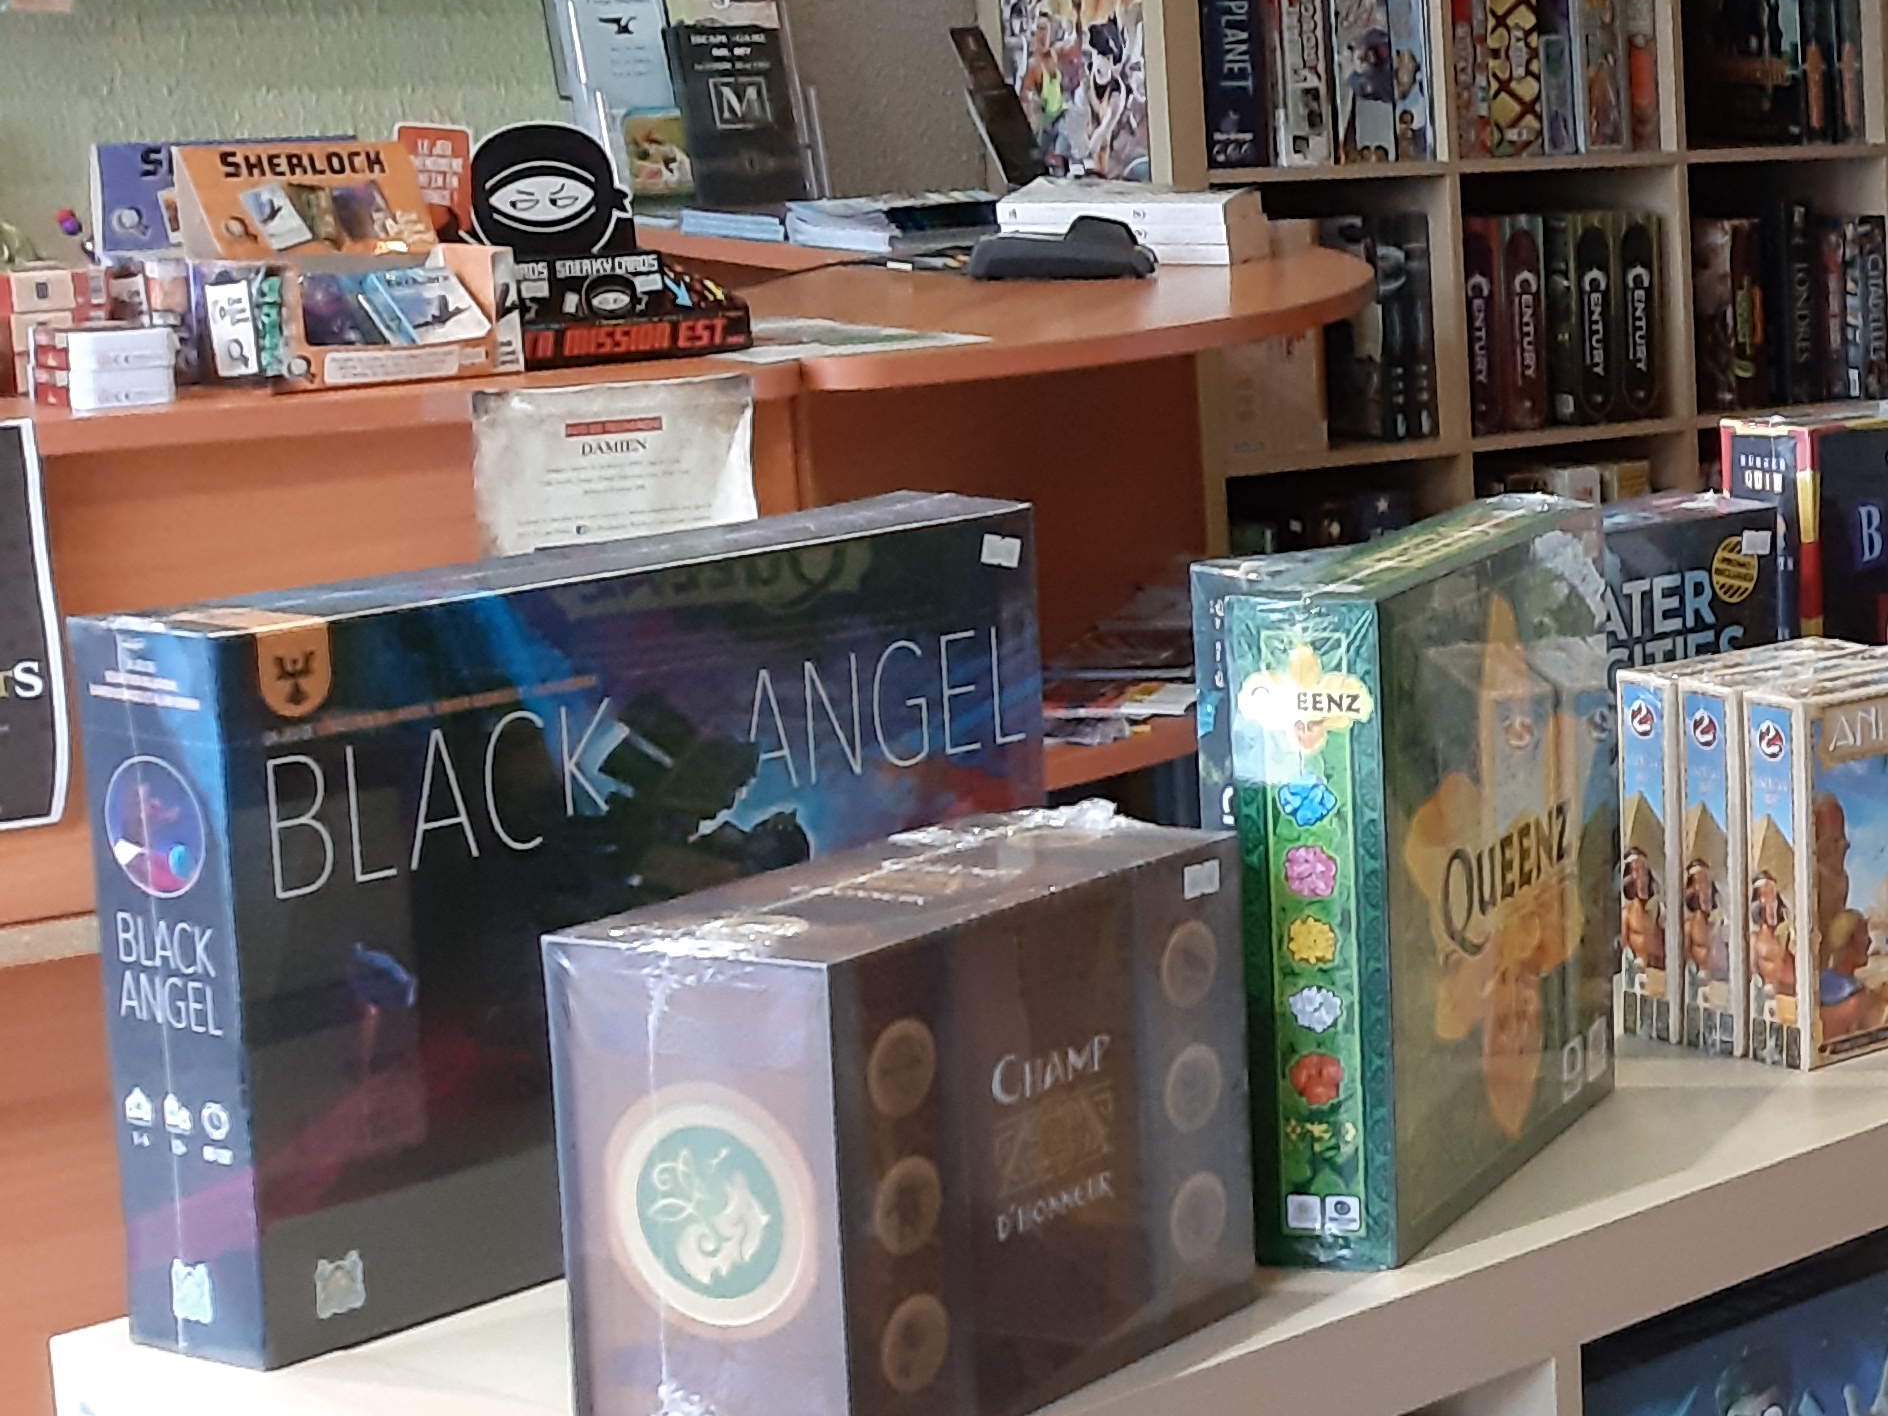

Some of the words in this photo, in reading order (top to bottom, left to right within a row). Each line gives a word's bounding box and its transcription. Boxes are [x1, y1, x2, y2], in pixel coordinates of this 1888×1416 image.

[1220, 0, 1253, 96] PLANET
[218, 149, 387, 180] SHERLOCK
[563, 321, 671, 357] MISSION
[1467, 272, 1491, 385] CENTURY
[1514, 268, 1539, 380] CENTURY
[1583, 266, 1608, 377] CENTURY
[1626, 263, 1651, 373] CENTURY
[580, 439, 649, 458] DAMIEN
[265, 696, 613, 902] BLACK
[748, 625, 1029, 788] ANGEL
[1443, 797, 1574, 957] QUEENZ
[116, 915, 217, 980] BLACK
[118, 973, 224, 1041] ANGEL
[989, 1032, 1115, 1106] CHAMP
[996, 1170, 1117, 1243] D'HONNEUR
